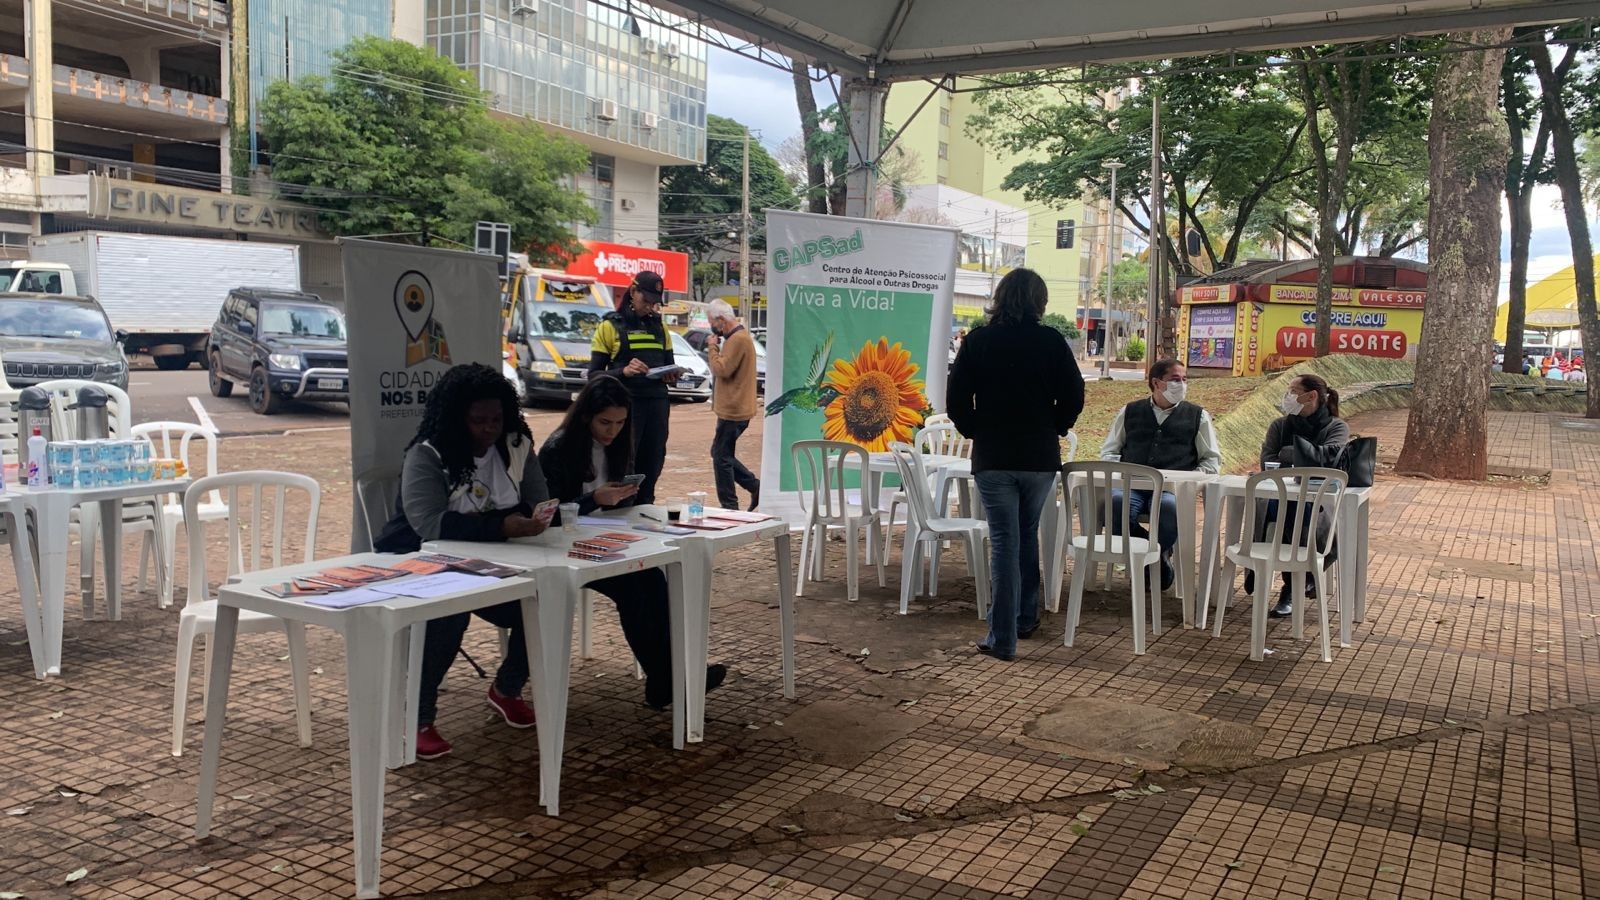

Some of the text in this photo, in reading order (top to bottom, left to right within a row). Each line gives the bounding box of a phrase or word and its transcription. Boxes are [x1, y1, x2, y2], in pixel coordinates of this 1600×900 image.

[111, 187, 198, 218] CINE
[773, 228, 864, 273] CAPSad
[822, 264, 947, 281] Centro de Atenção Psicossocial
[829, 276, 848, 284] para
[883, 279, 911, 288] Outras
[912, 281, 939, 291] Drogas
[786, 286, 895, 311] Viva a Vida!
[1276, 289, 1306, 300] BANCA
[1363, 293, 1426, 303] VALE SOR
[1301, 311, 1387, 325] COPRE AQUI!
[1338, 333, 1402, 350] SORTE
[381, 391, 413, 406] NOS
